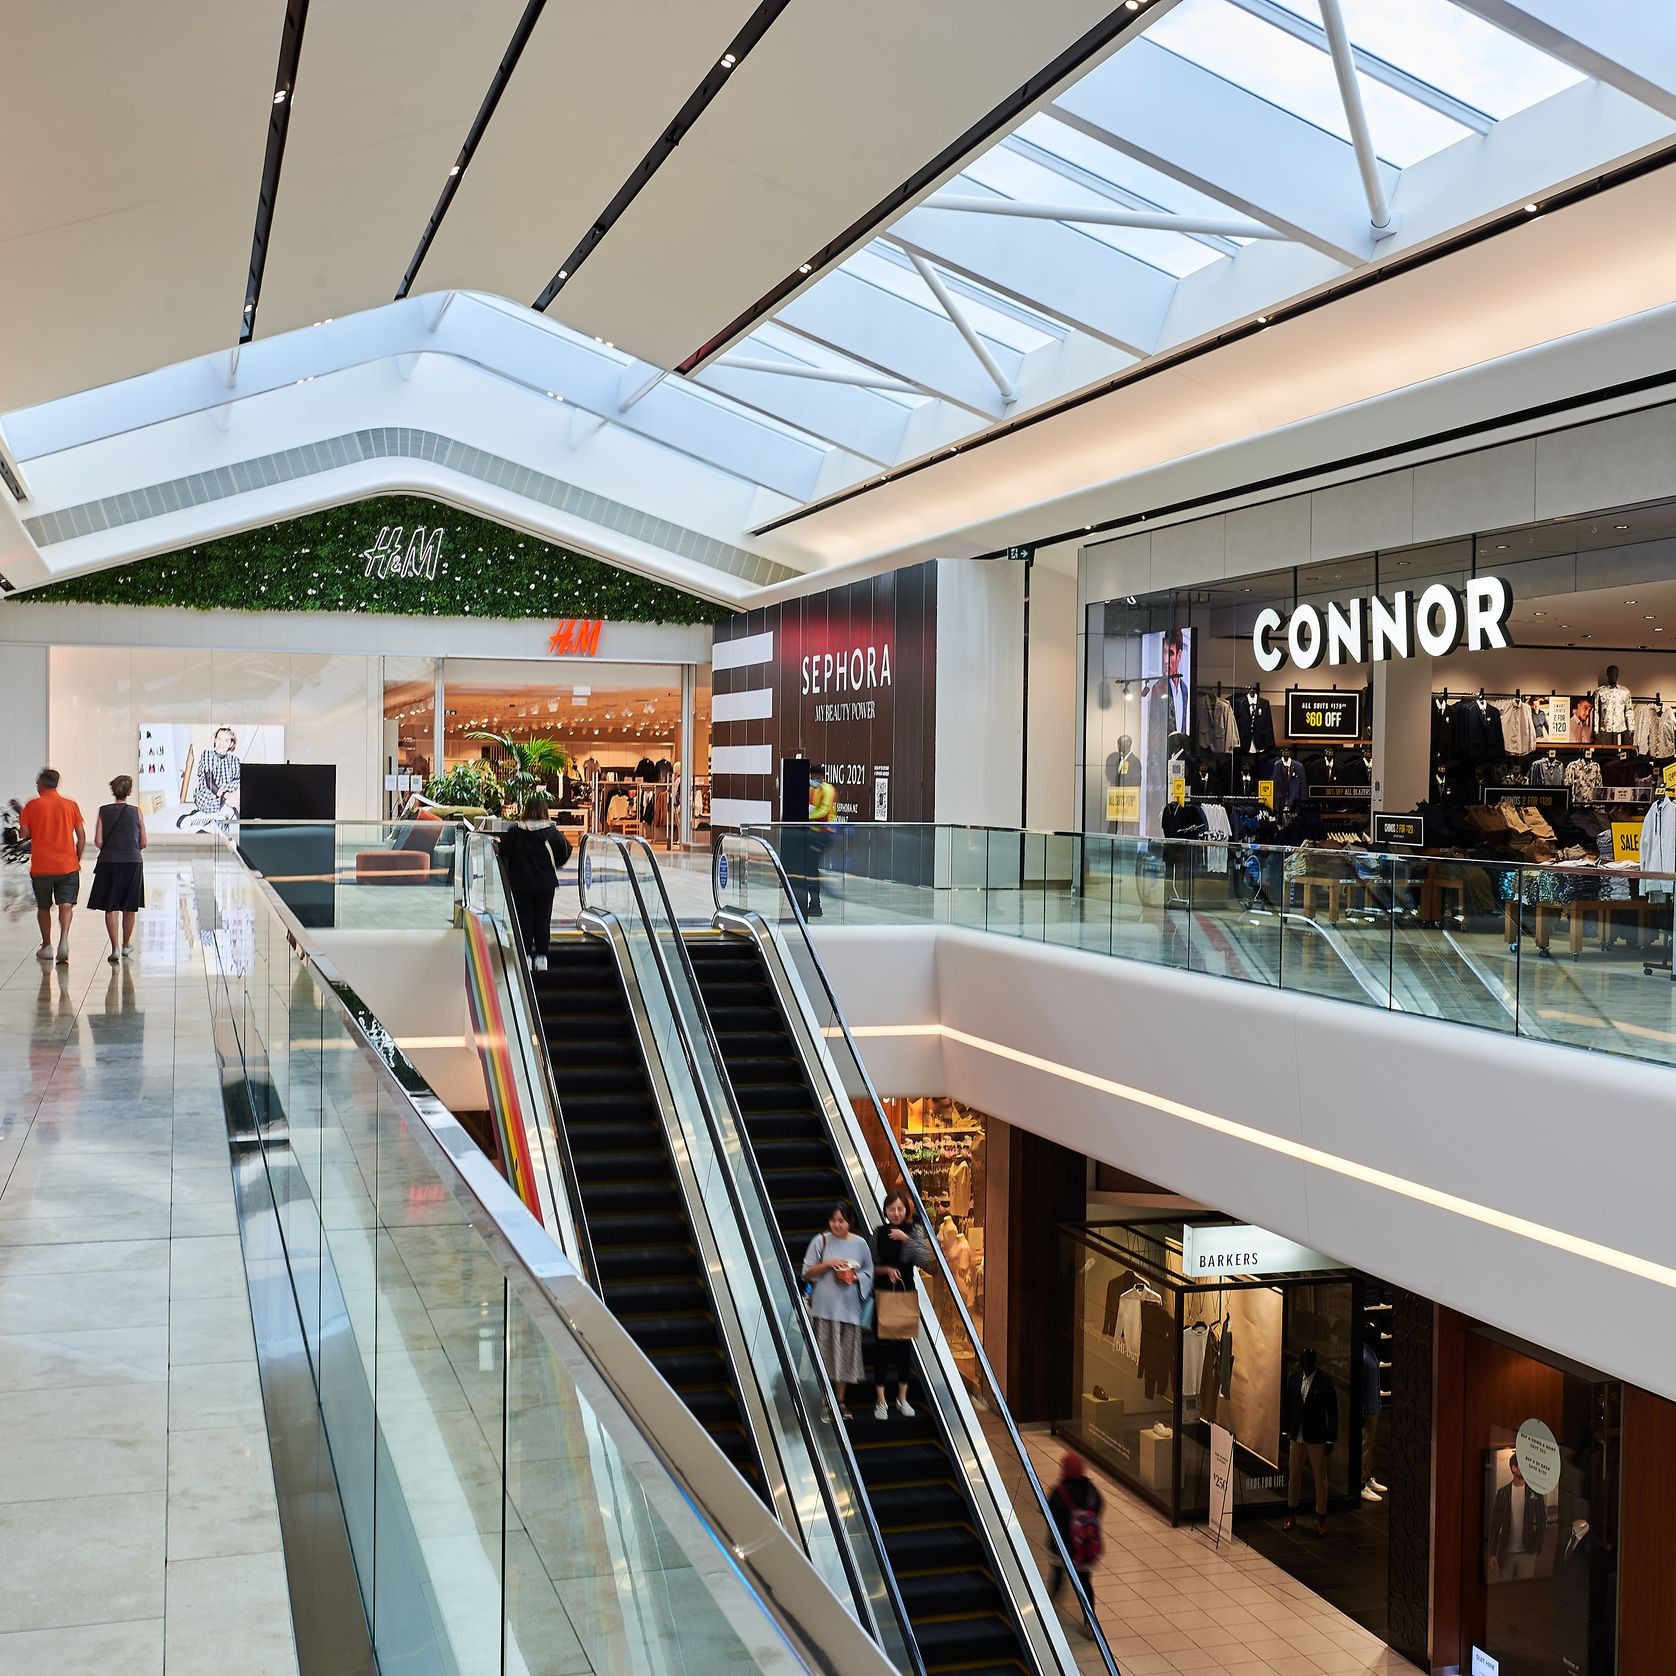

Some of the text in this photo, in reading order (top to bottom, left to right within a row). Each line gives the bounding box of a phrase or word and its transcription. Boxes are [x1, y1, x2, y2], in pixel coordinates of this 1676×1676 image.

[364, 526, 443, 580] H&M
[1253, 576, 1514, 672] CONNOR
[550, 618, 602, 656] H&M
[802, 643, 891, 695] SEPHORA
[815, 700, 876, 722] MY BEAUTY POWER
[1302, 702, 1312, 710] ALL
[1313, 702, 1328, 710] SUITS
[1306, 711, 1342, 728] $60 OFF
[1554, 714, 1566, 722] 2 FOR
[1552, 722, 1567, 732] $120
[846, 764, 865, 785] 2021
[1336, 788, 1344, 796] OFF
[1344, 788, 1352, 796] ALL
[1527, 796, 1538, 806] FOR
[1620, 834, 1640, 851] SALE
[1199, 1252, 1258, 1268] BARKERS
[1262, 1476, 1272, 1488] FOR
